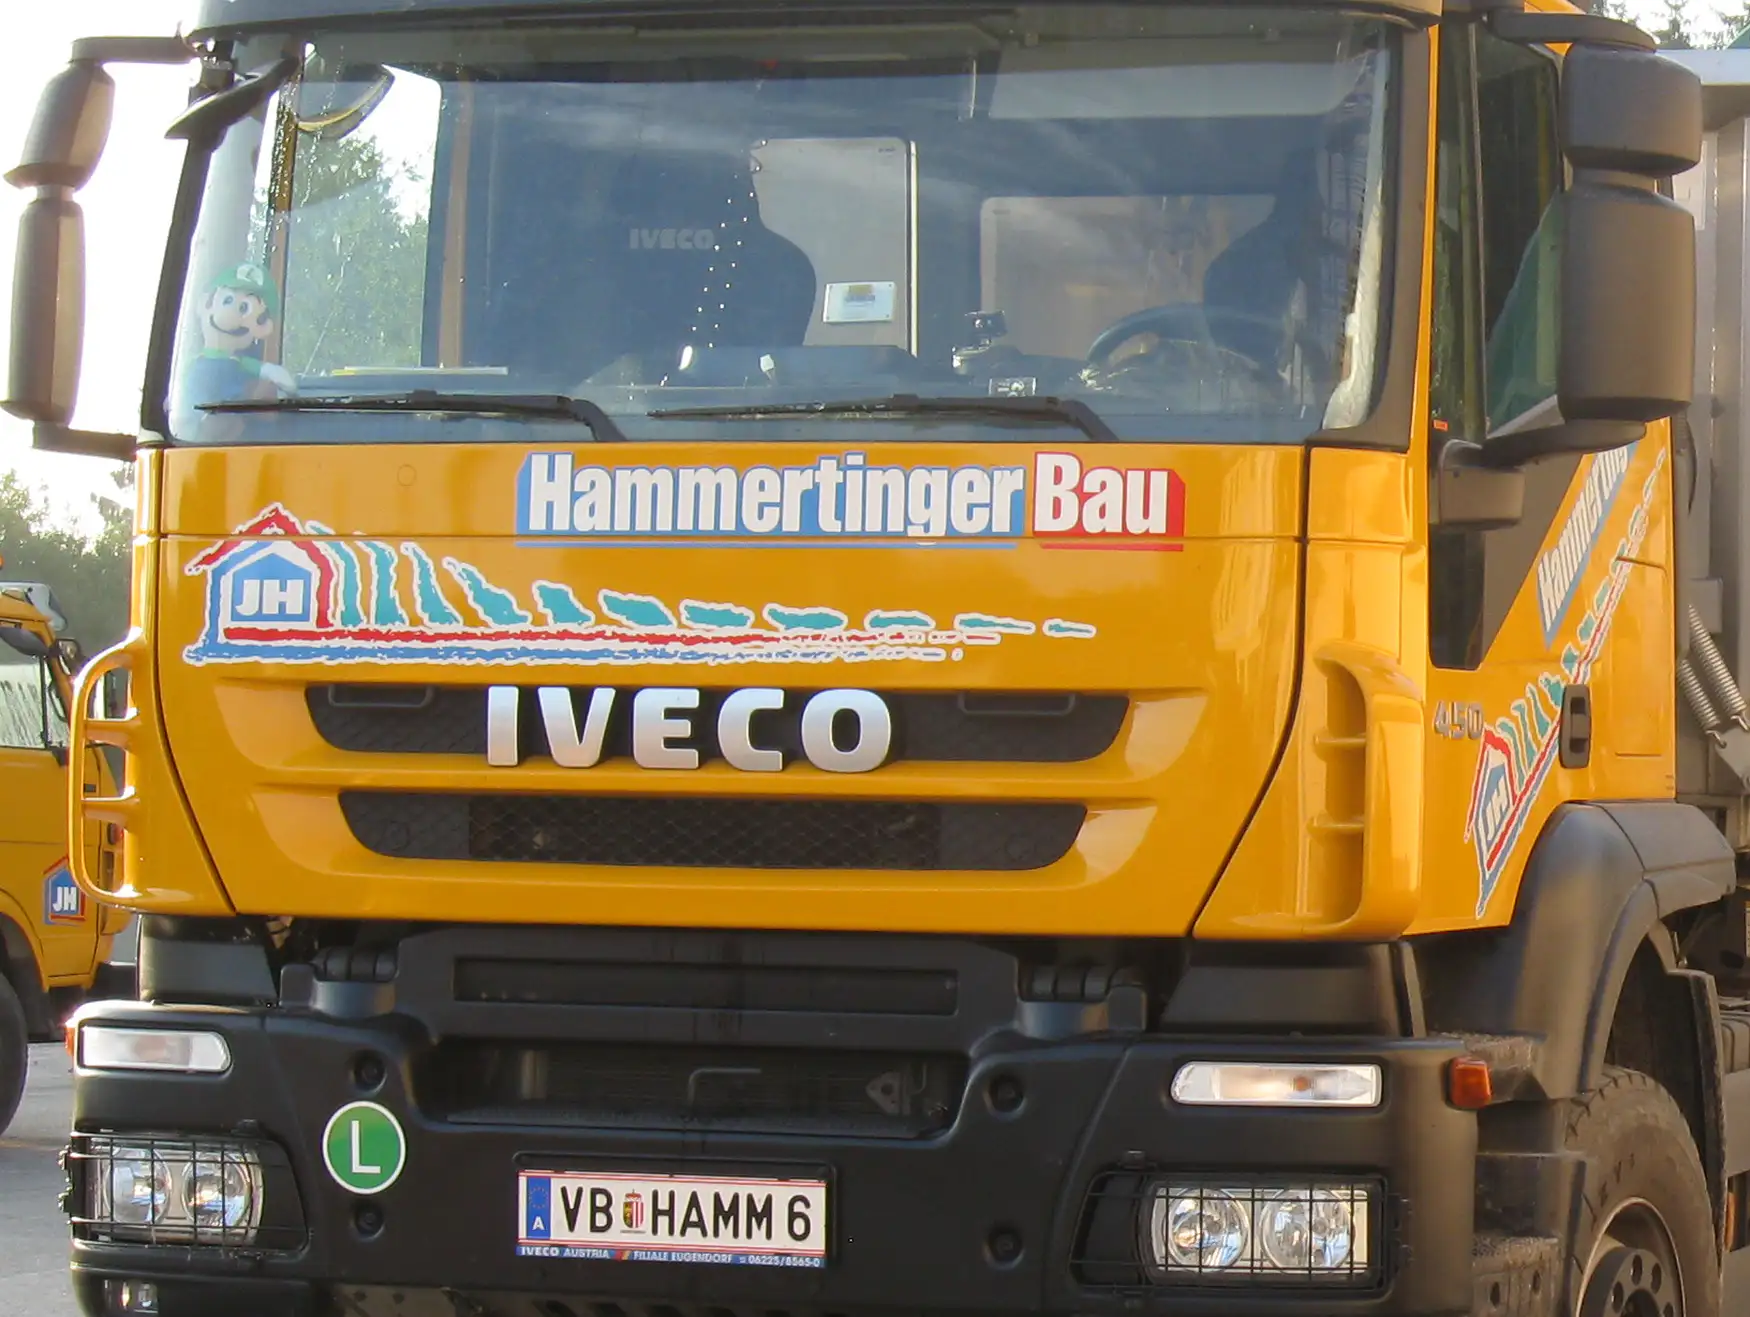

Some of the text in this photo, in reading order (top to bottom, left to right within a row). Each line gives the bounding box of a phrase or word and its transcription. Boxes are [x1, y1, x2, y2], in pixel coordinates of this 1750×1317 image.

[629, 228, 715, 249] IVECO
[529, 452, 1168, 545] Hammertinger Bau
[235, 579, 304, 616] JH
[487, 686, 892, 773] IVECO
[1434, 700, 1484, 740] 450
[52, 886, 77, 912] JH
[351, 1120, 381, 1174] L
[532, 1216, 545, 1231] A
[560, 1186, 811, 1242] VB HAMM 6
[520, 1246, 559, 1257] IVECO
[563, 1248, 610, 1259] AUSTRIA
[633, 1250, 668, 1261] FILIALE
[671, 1252, 732, 1263] EUGENDORF
